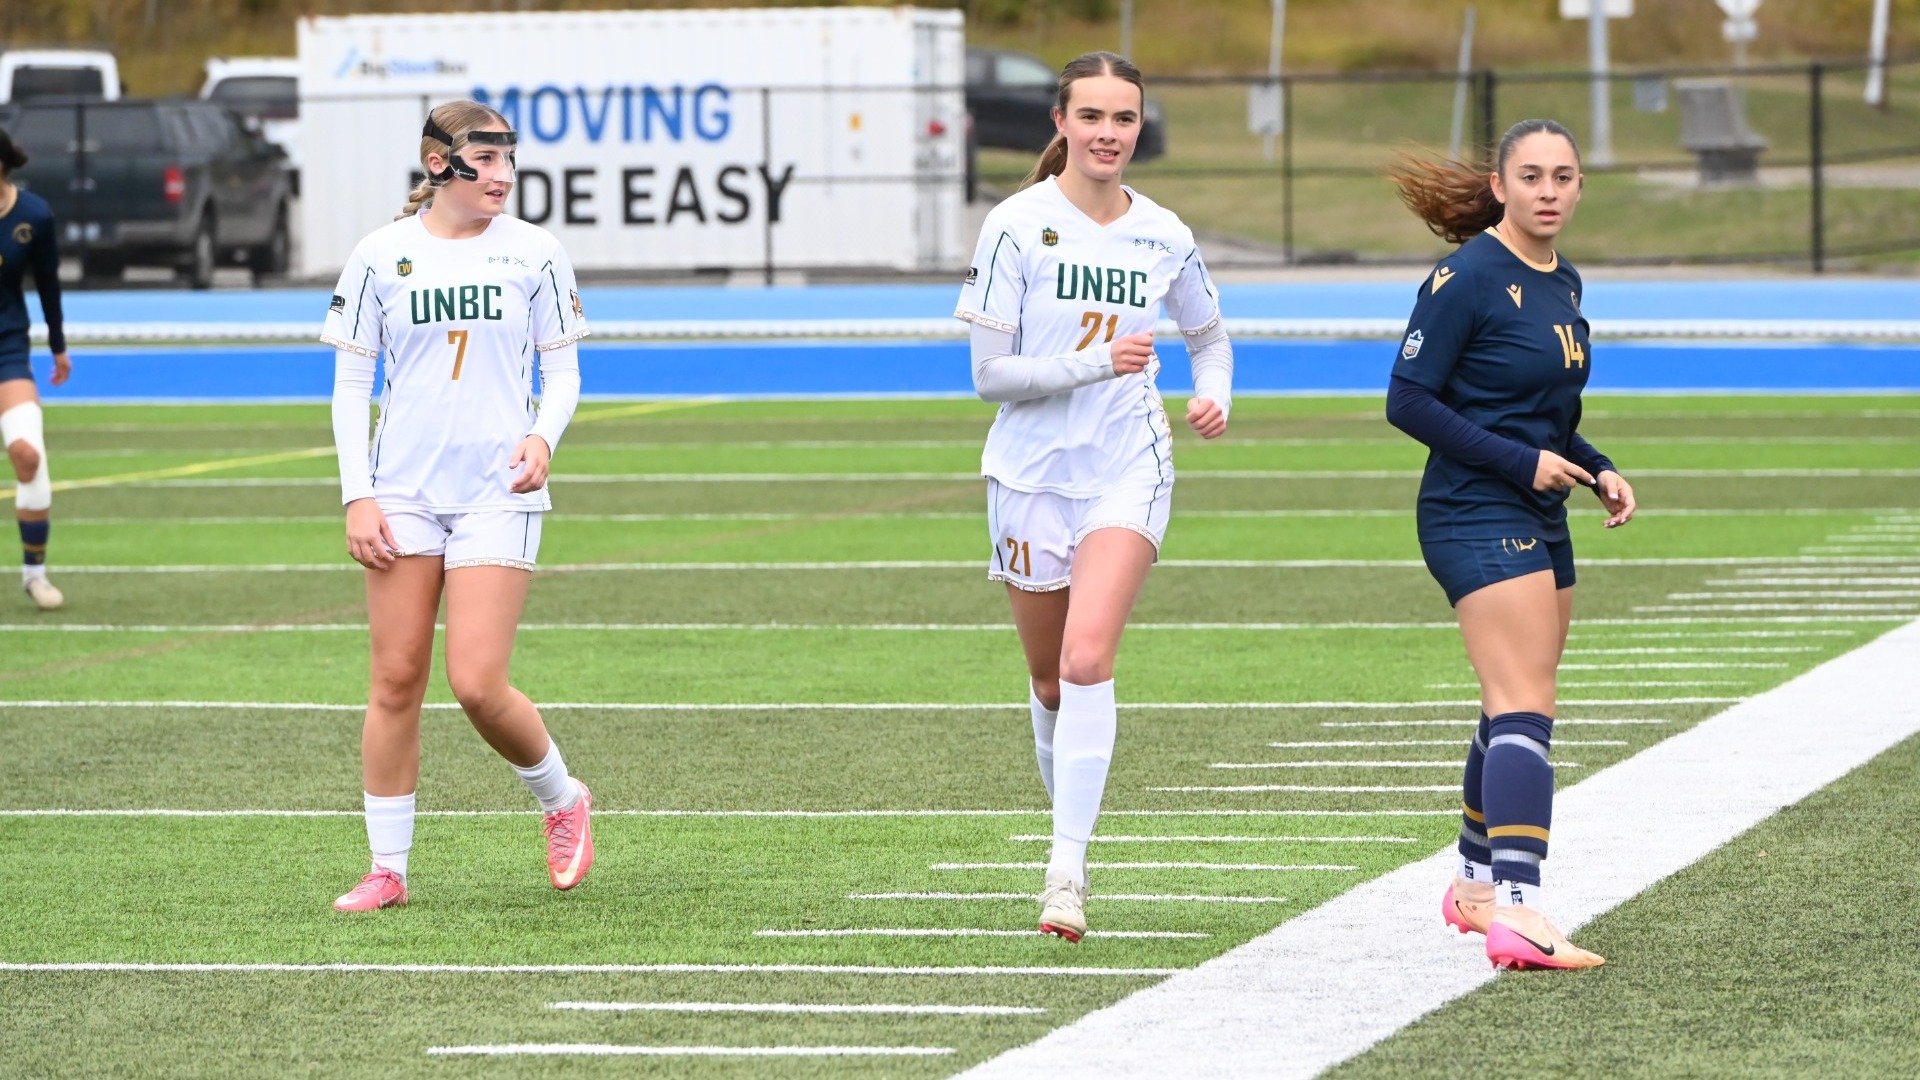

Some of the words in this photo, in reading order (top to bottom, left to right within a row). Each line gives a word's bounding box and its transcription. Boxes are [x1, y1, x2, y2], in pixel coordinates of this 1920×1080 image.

[623, 165, 795, 225] EASY
[410, 284, 502, 325] UNBC
[1056, 262, 1148, 308] UNBC
[1075, 311, 1119, 351] 21
[1553, 324, 1584, 369] 14
[447, 329, 468, 381] 7
[1006, 537, 1031, 577] 21
